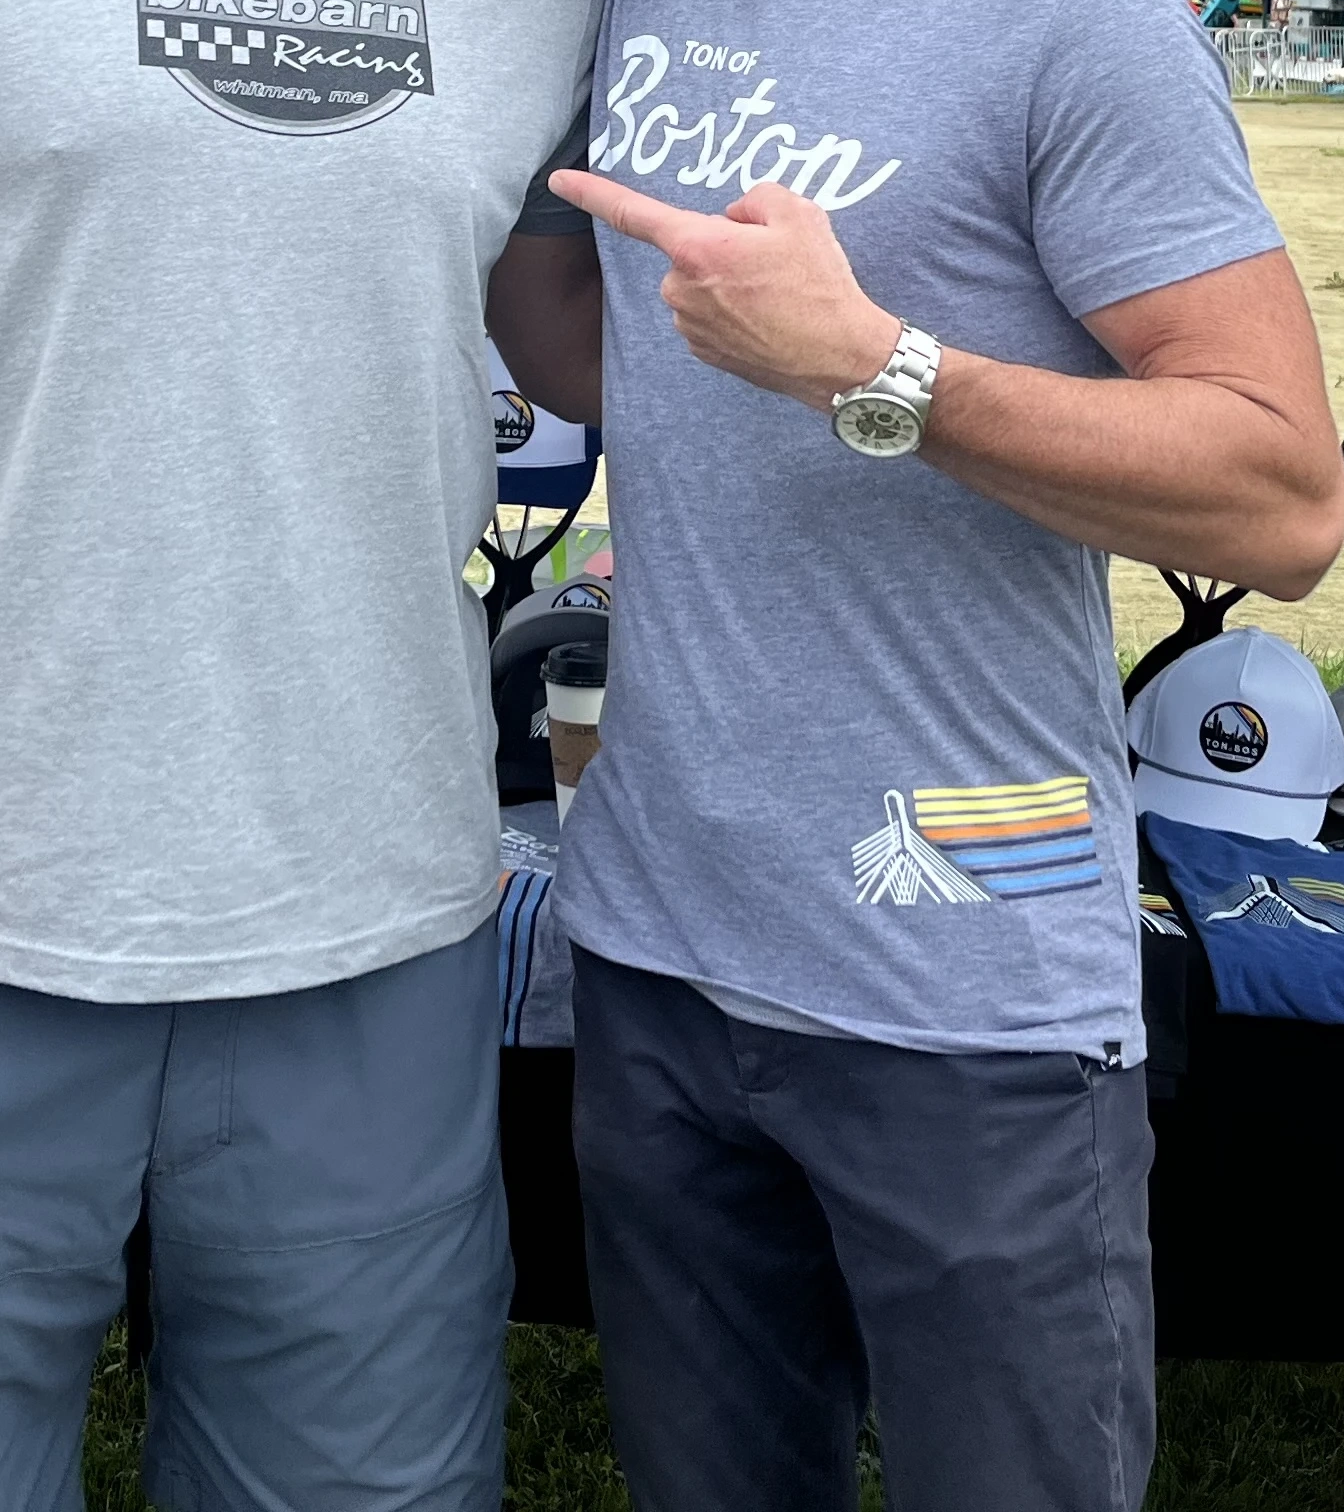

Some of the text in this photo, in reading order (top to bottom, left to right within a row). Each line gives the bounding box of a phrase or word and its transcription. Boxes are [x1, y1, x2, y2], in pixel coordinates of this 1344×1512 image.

[272, 34, 425, 86] Racing
[682, 40, 761, 75] TON OF
[213, 79, 369, 105] whitman, ma
[588, 34, 902, 211] Boston
[1205, 737, 1229, 751] TON
[1233, 744, 1258, 757] BOS
